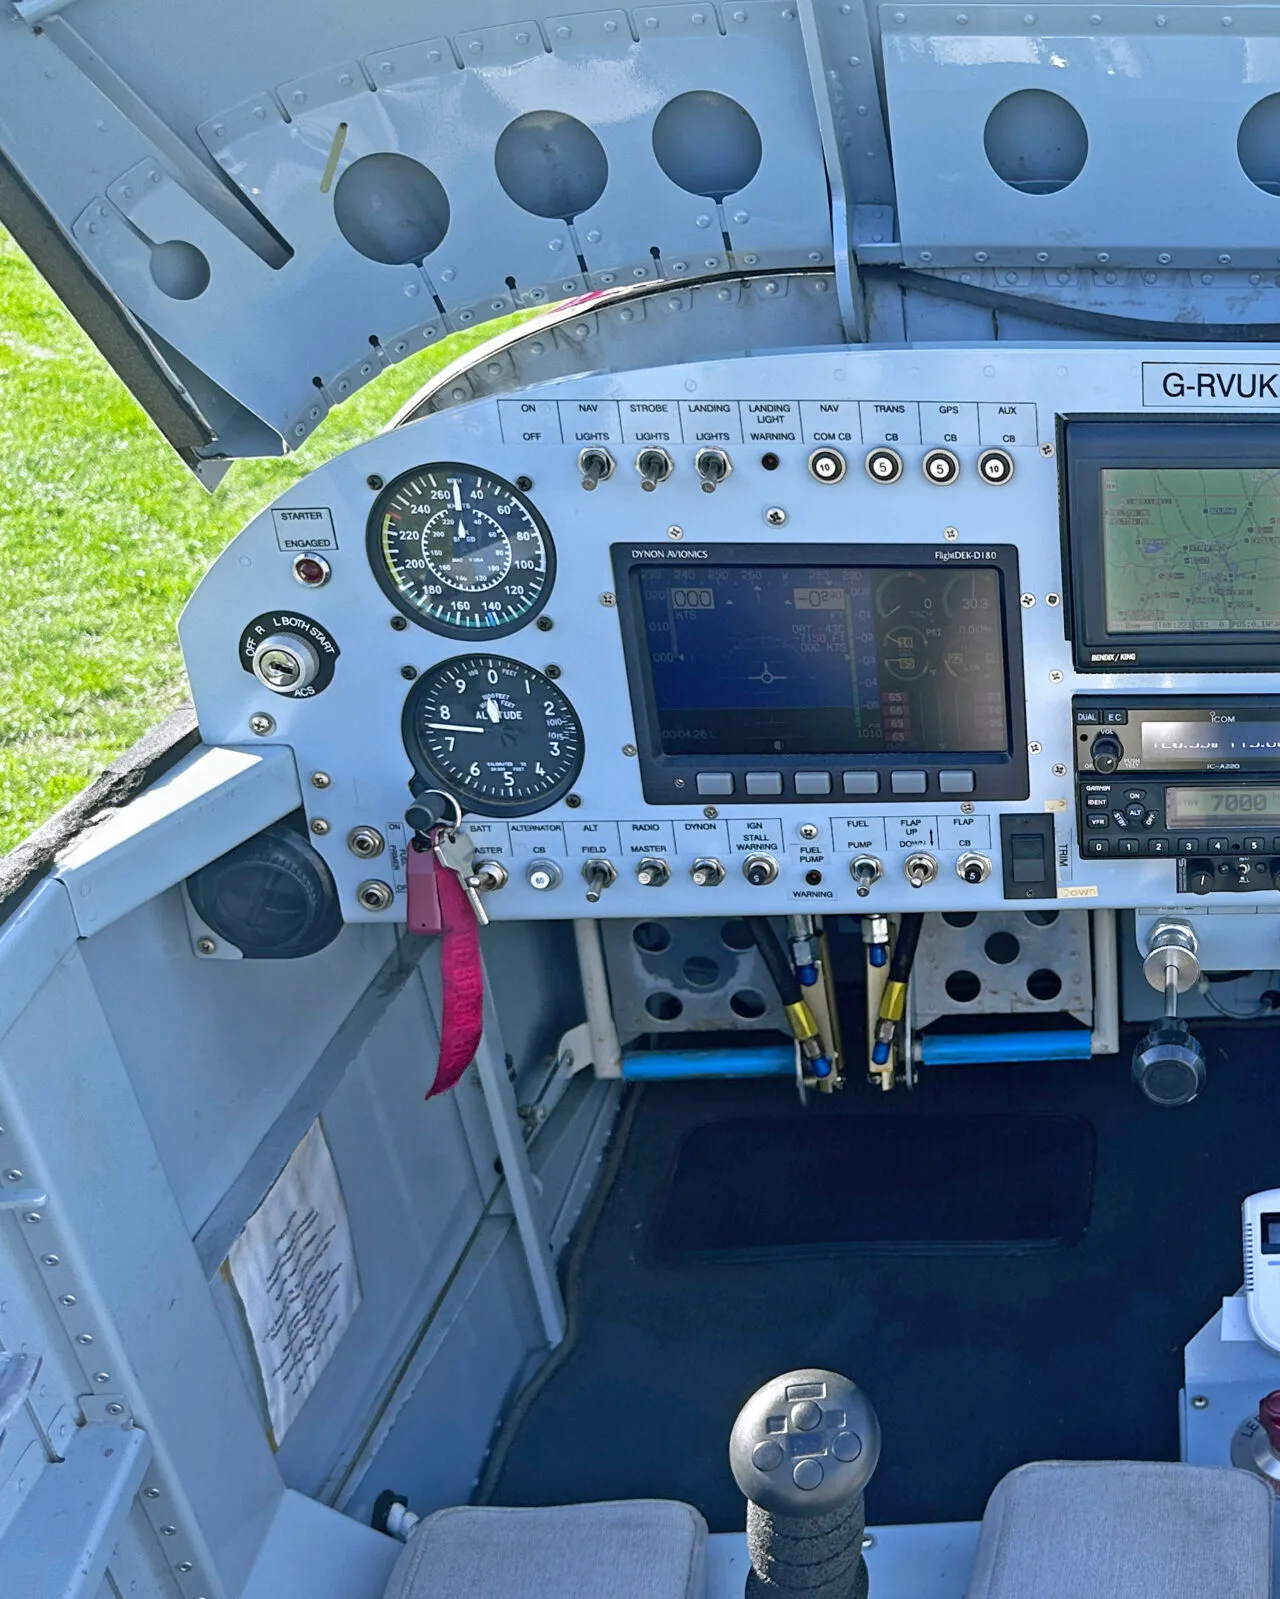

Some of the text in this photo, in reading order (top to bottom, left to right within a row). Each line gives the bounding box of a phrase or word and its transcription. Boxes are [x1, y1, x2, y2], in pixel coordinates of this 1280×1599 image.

[1163, 373, 1279, 398] G-RVUK
[521, 404, 537, 413] ON
[579, 404, 598, 413] NAV
[630, 404, 669, 413] STROBE
[688, 404, 731, 413] LANDING
[748, 404, 791, 413] LANDING
[820, 404, 839, 413] NAV
[874, 405, 905, 414] TRANS
[939, 405, 959, 415] GPS
[998, 406, 1017, 415] AUX
[757, 415, 784, 424] LIGHT
[522, 432, 542, 441] OFF
[575, 432, 610, 441] LIGHTS
[635, 432, 670, 441] LIGHTS
[696, 432, 730, 441] LIGHTS
[750, 432, 796, 442] WARNING
[813, 432, 852, 441] COM CB
[885, 433, 899, 441] CB
[943, 433, 958, 442] CB
[1002, 434, 1016, 443] CB
[431, 490, 450, 500] 260
[470, 490, 484, 500] 40
[411, 504, 431, 514] 240
[497, 505, 511, 515] 60
[281, 512, 323, 521] STARTER
[400, 531, 419, 541] 220
[517, 531, 530, 541] 80
[285, 539, 330, 548] ENGAGED
[632, 550, 708, 559] DYNON AVIONICS
[935, 550, 997, 561] FlightDEK-D180
[405, 559, 425, 569] 200
[514, 560, 534, 570] 100
[741, 570, 762, 580] 260
[422, 585, 442, 595] 180
[504, 585, 524, 595] 120
[674, 590, 711, 607] 000
[451, 601, 470, 611] 160
[482, 601, 502, 611] 140
[676, 611, 697, 620] KTS
[281, 617, 310, 631] BOTH
[649, 622, 670, 631] 010
[309, 627, 335, 655] START
[246, 637, 257, 657] OFF
[826, 643, 847, 653] KTS
[653, 653, 673, 662] 000
[1091, 653, 1136, 662] BENDIX KING
[502, 669, 517, 678] FEET
[294, 686, 315, 697] ACS
[1078, 713, 1096, 721] DUAL
[1211, 794, 1267, 811] 7000
[847, 820, 869, 828] FUEL
[953, 818, 974, 826] FLAP
[1113, 813, 1127, 828] STBY
[583, 824, 598, 832] ALT
[632, 824, 660, 832] RADIO
[685, 823, 716, 831] DYNON
[631, 845, 667, 853] MASTER
[736, 843, 778, 851] WARNING
[1059, 844, 1068, 867] TRIM
[1241, 1416, 1260, 1438] LE
